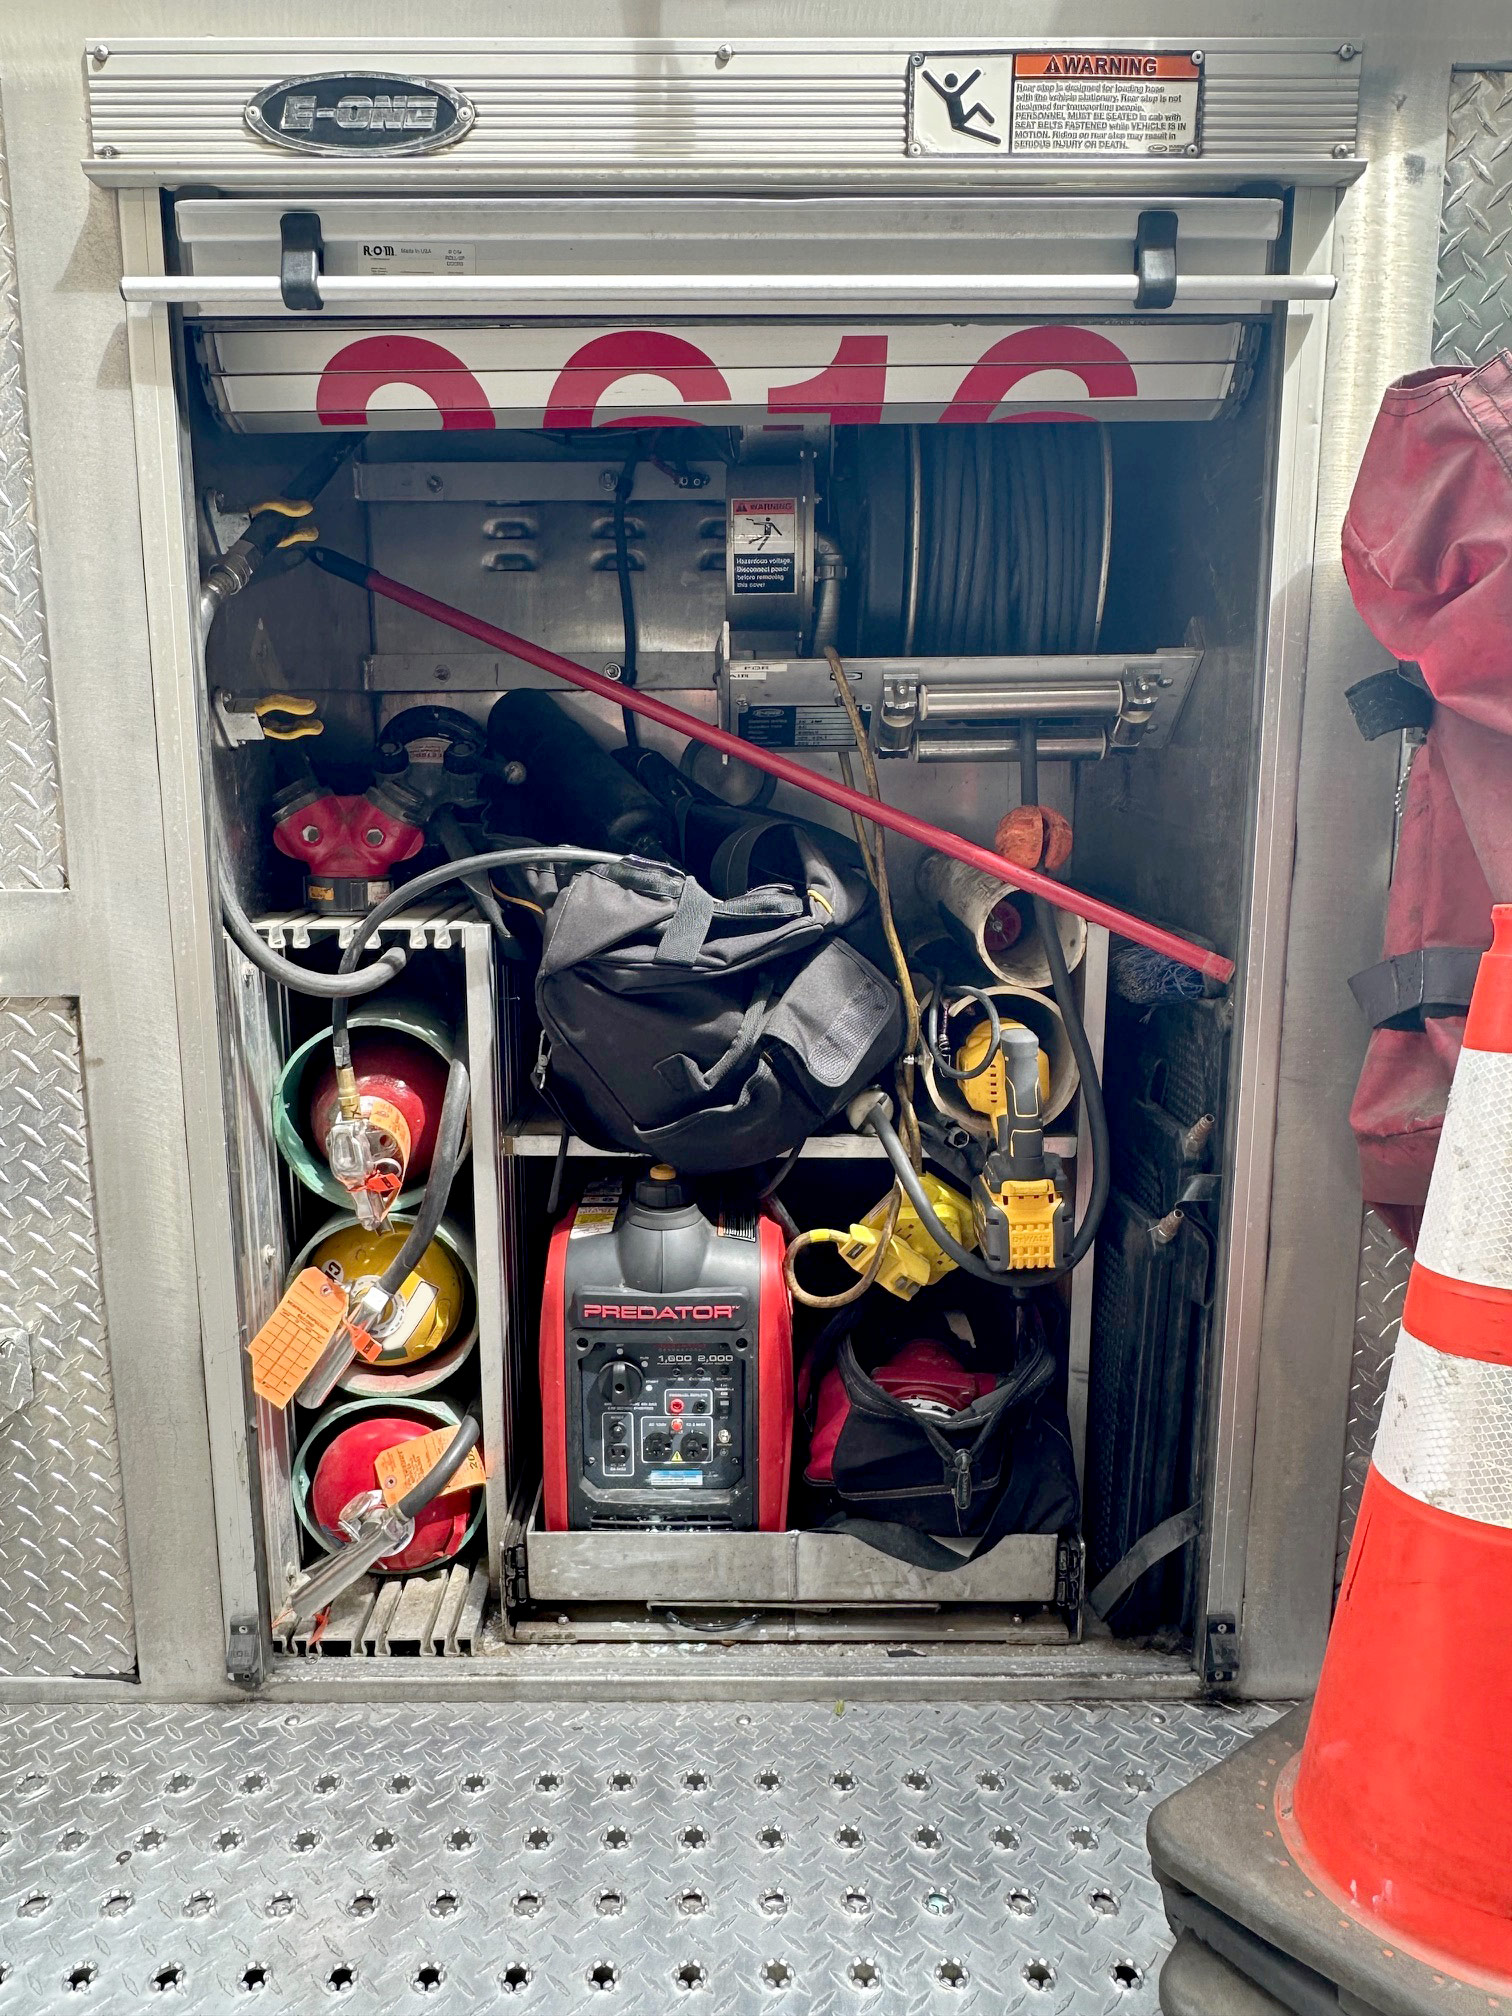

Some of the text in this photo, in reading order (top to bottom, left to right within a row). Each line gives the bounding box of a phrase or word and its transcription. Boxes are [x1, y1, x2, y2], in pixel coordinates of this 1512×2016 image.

[1062, 55, 1157, 76] WARNING
[1168, 95, 1182, 103] not
[279, 95, 439, 131] E-ONE
[1067, 112, 1092, 121] MUST
[1093, 112, 1105, 121] BE
[1106, 112, 1138, 121] SEATED
[1014, 121, 1036, 131] SEAT
[1037, 121, 1063, 131] BELTS
[1064, 121, 1108, 131] FASTENED
[1130, 122, 1166, 131] VEHICLE
[1168, 122, 1176, 131] IS
[1177, 122, 1187, 131] IN
[1052, 140, 1083, 150] INJURY
[1084, 140, 1097, 150] OR
[750, 502, 793, 511] WARNING
[736, 557, 768, 565] Hazardous
[771, 566, 790, 574] power
[583, 1304, 734, 1319] PREDATOR
[697, 1355, 734, 1363] 2,000
